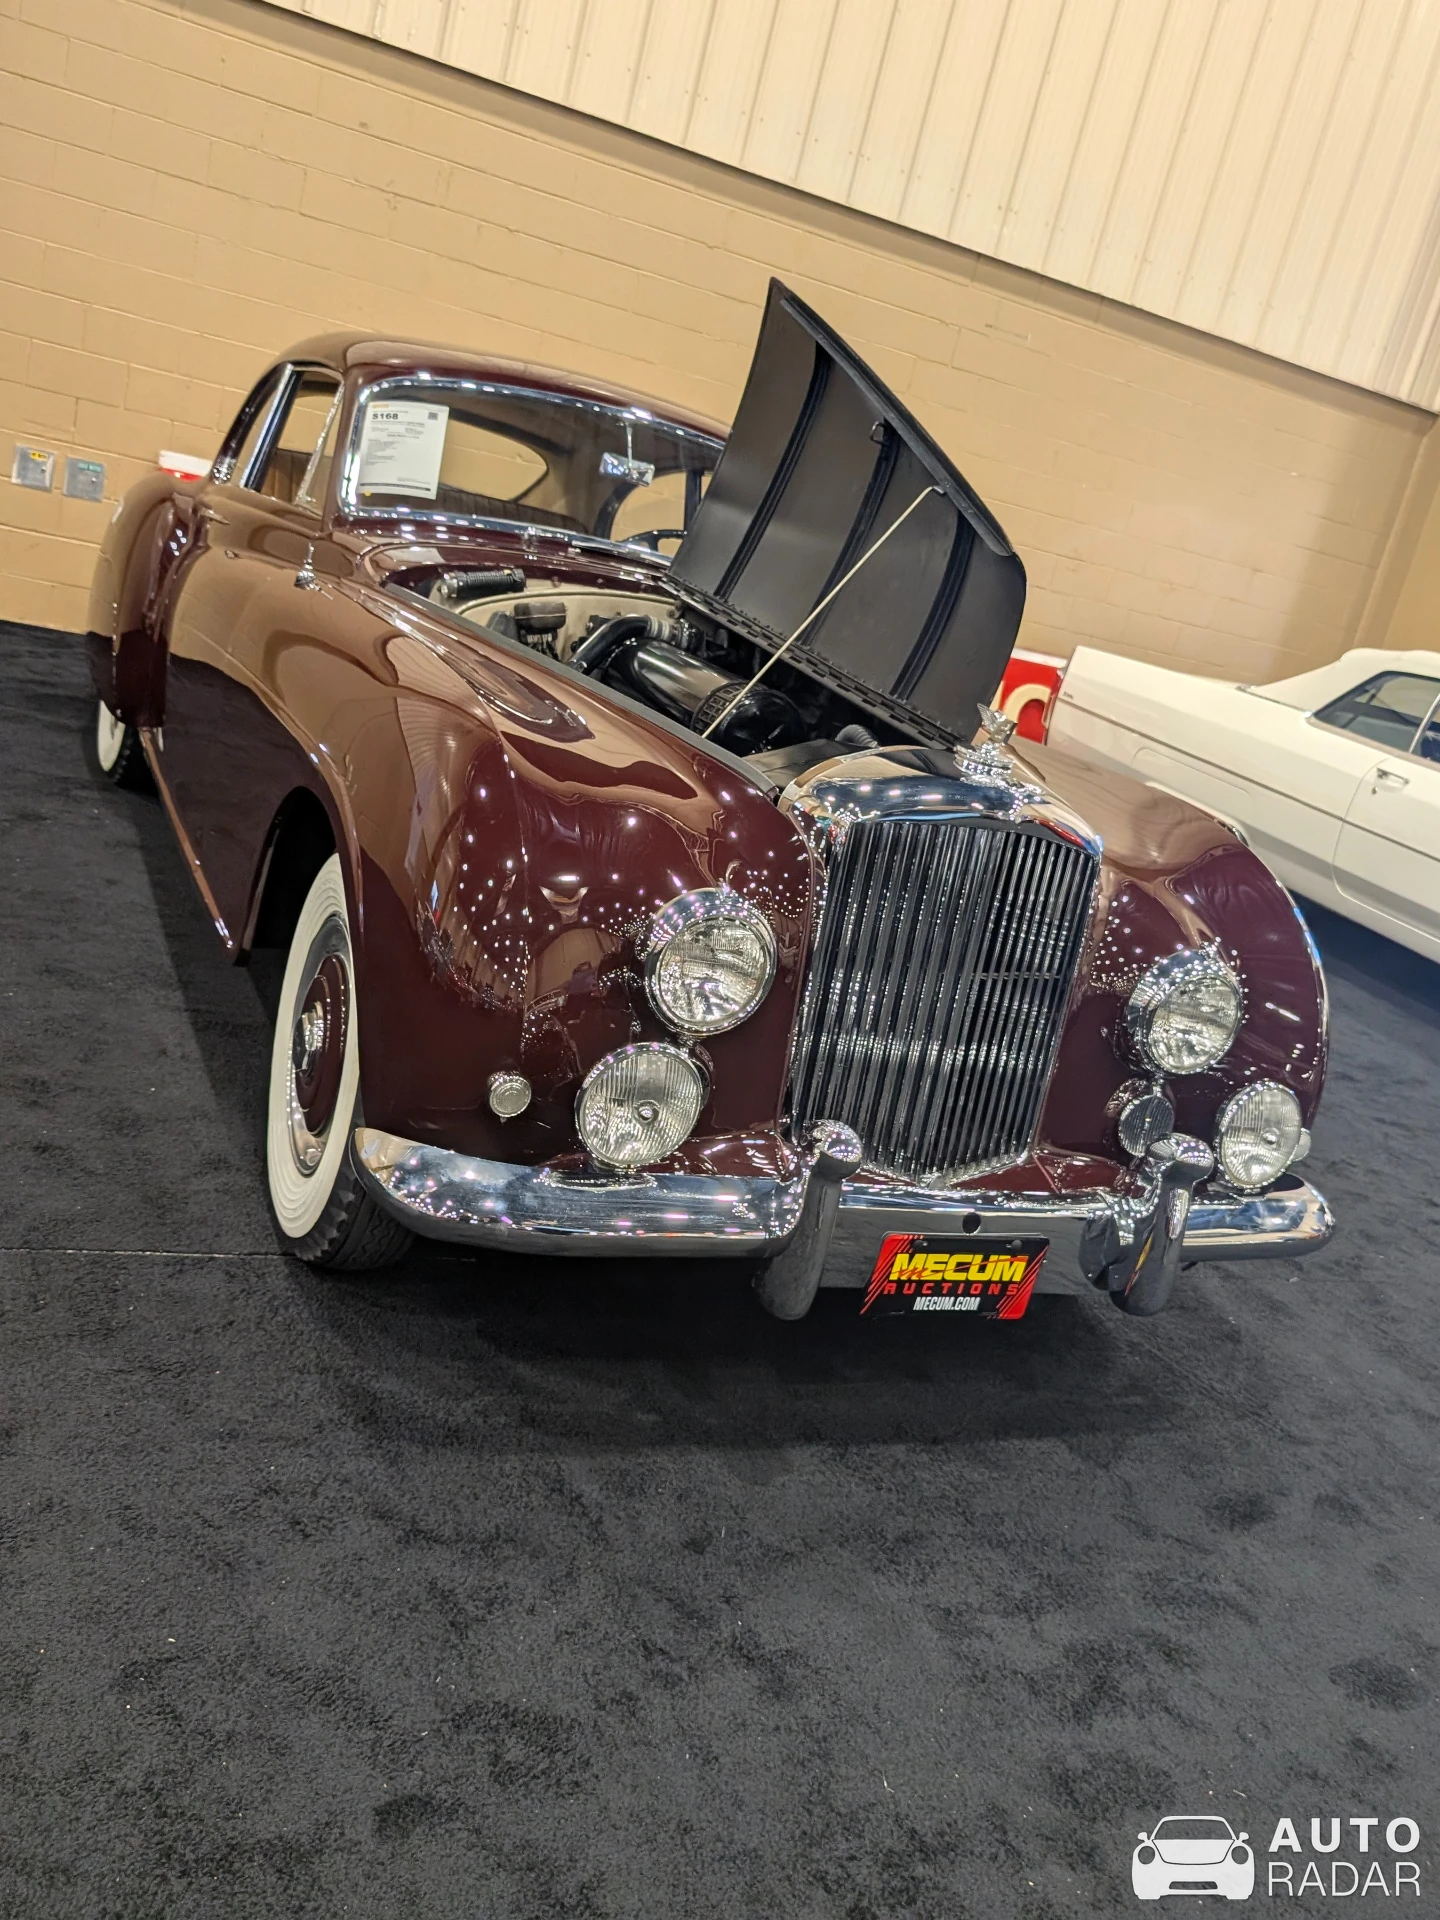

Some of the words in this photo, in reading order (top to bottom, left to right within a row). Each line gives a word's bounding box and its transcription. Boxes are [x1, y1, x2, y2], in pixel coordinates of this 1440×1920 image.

[371, 412, 399, 420] S168
[888, 1253, 1029, 1281] MECUM
[883, 1282, 1020, 1294] AUCTIONS
[913, 1296, 981, 1311] MECUM.COM
